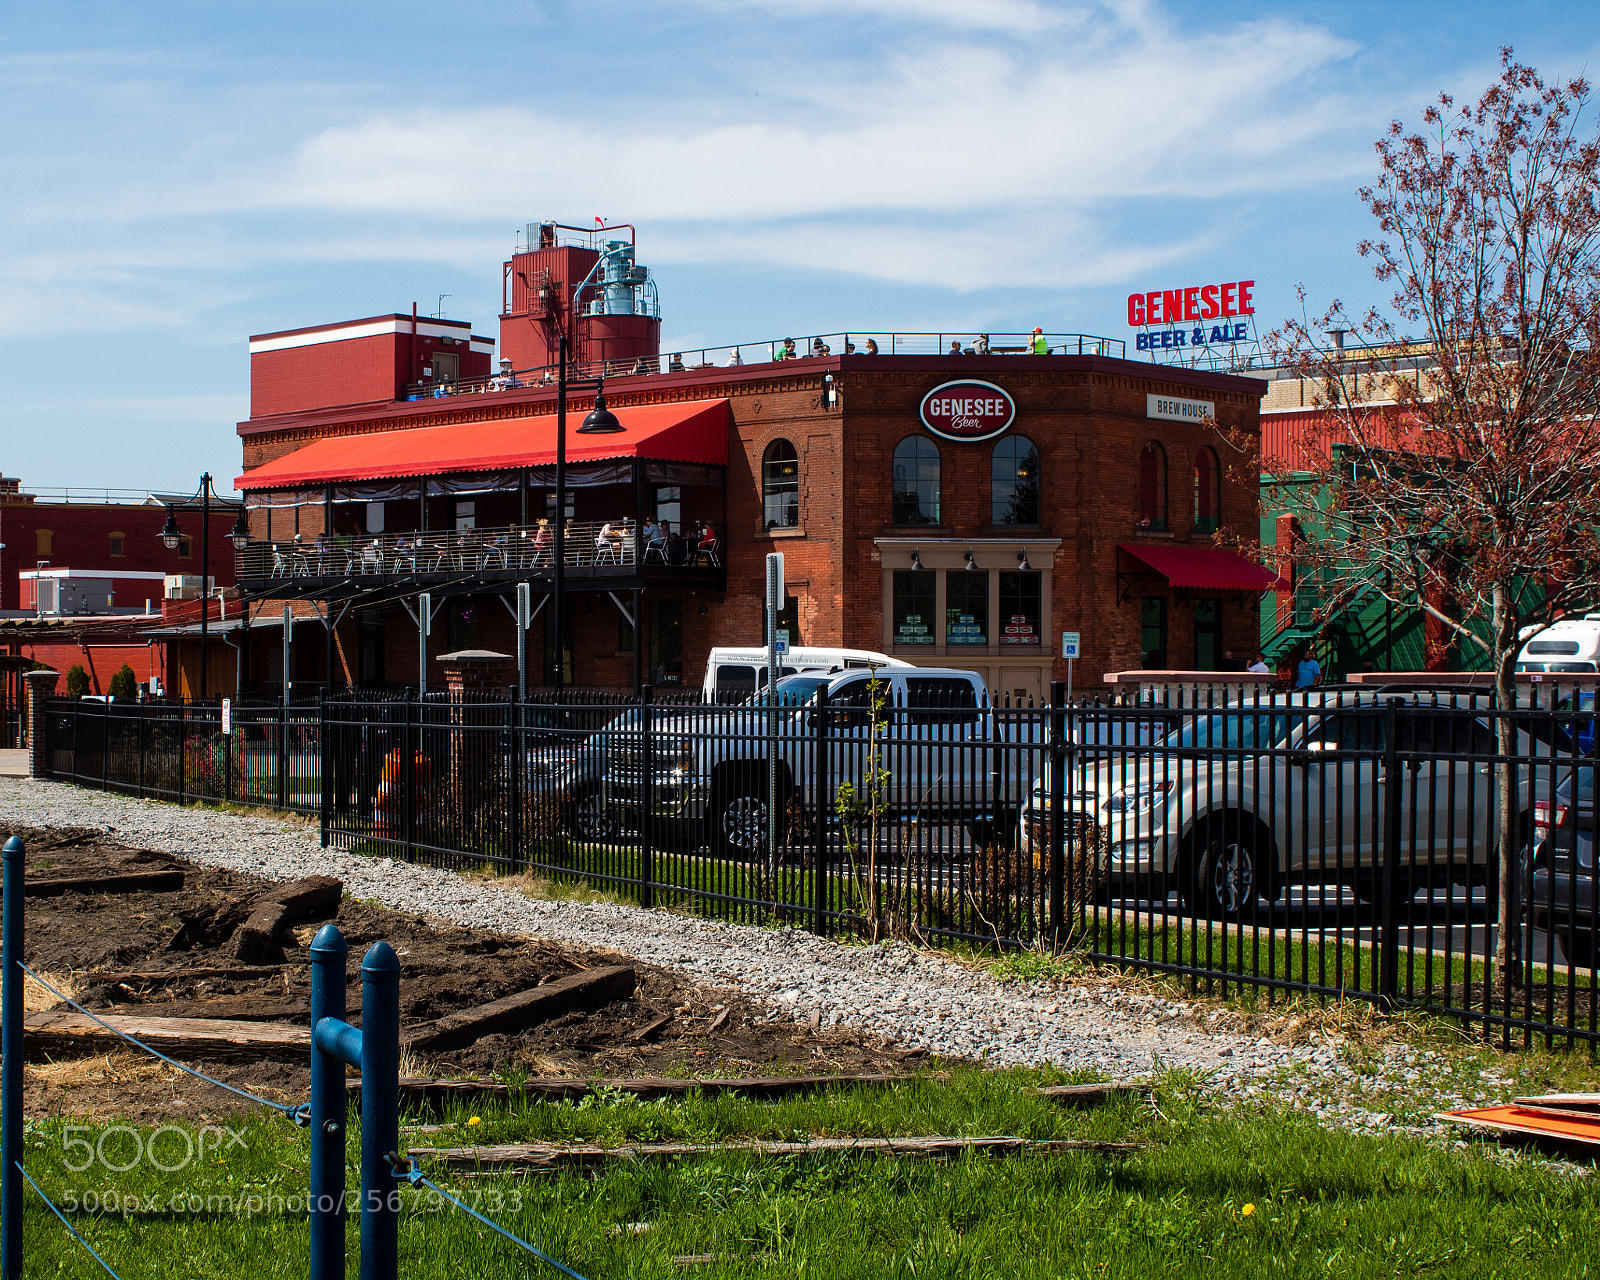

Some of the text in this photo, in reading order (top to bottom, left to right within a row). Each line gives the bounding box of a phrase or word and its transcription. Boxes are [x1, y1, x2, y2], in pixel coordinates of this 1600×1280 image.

[1128, 280, 1255, 326] GENESEE
[1136, 323, 1247, 350] BEER & ALE
[930, 398, 1004, 416] GENESEE
[1157, 400, 1180, 415] BREW
[951, 414, 982, 429] Beer
